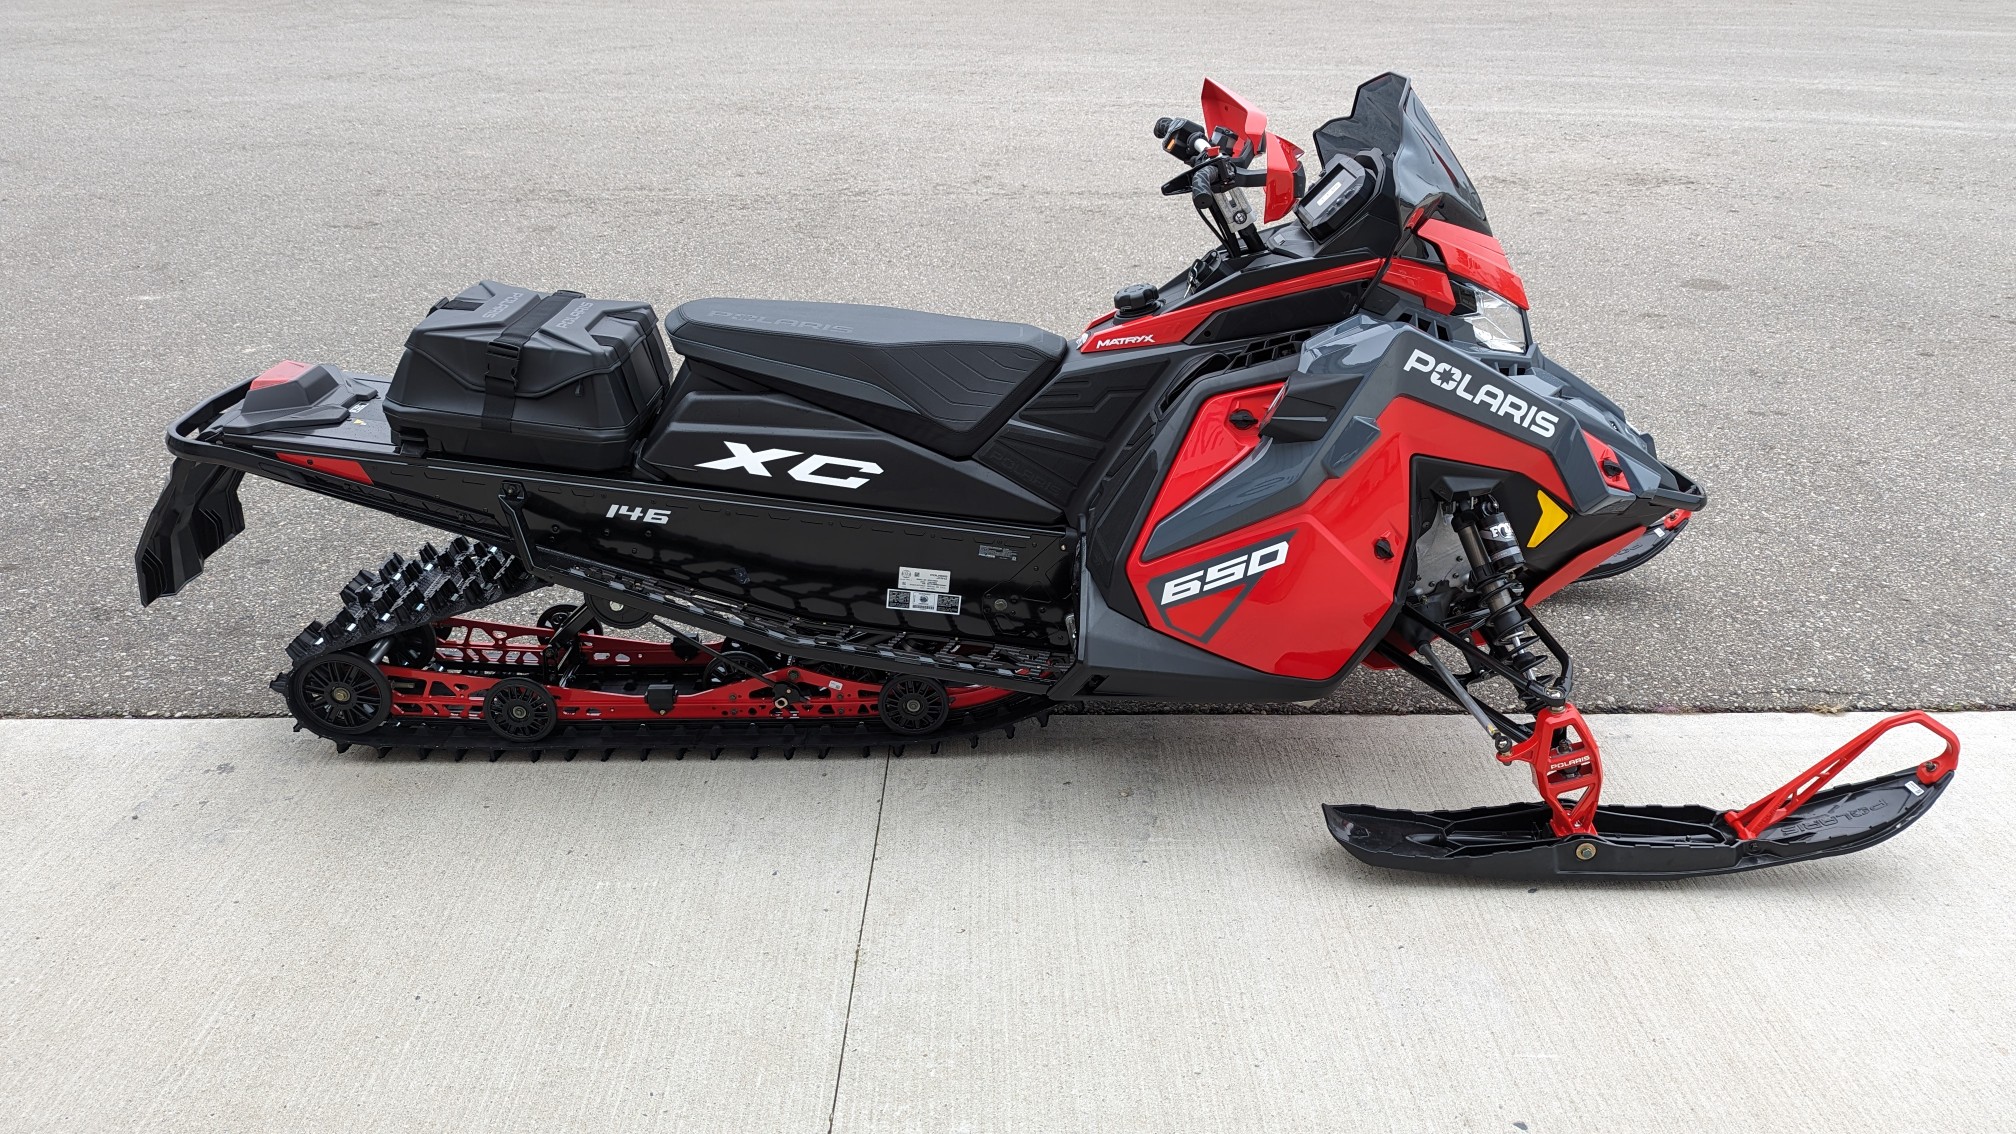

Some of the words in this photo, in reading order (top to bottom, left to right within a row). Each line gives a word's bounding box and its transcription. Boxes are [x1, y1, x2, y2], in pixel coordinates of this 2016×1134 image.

[556, 301, 594, 329] POLARIS
[708, 310, 854, 334] POLARIS
[1096, 334, 1156, 349] MATRYX
[1403, 349, 1559, 438] POLARIS
[694, 441, 884, 489] XC
[605, 504, 672, 525] 146
[1161, 541, 1289, 606] 650
[1550, 755, 1591, 770] POLARIS
[1780, 798, 1888, 837] POLARIS
